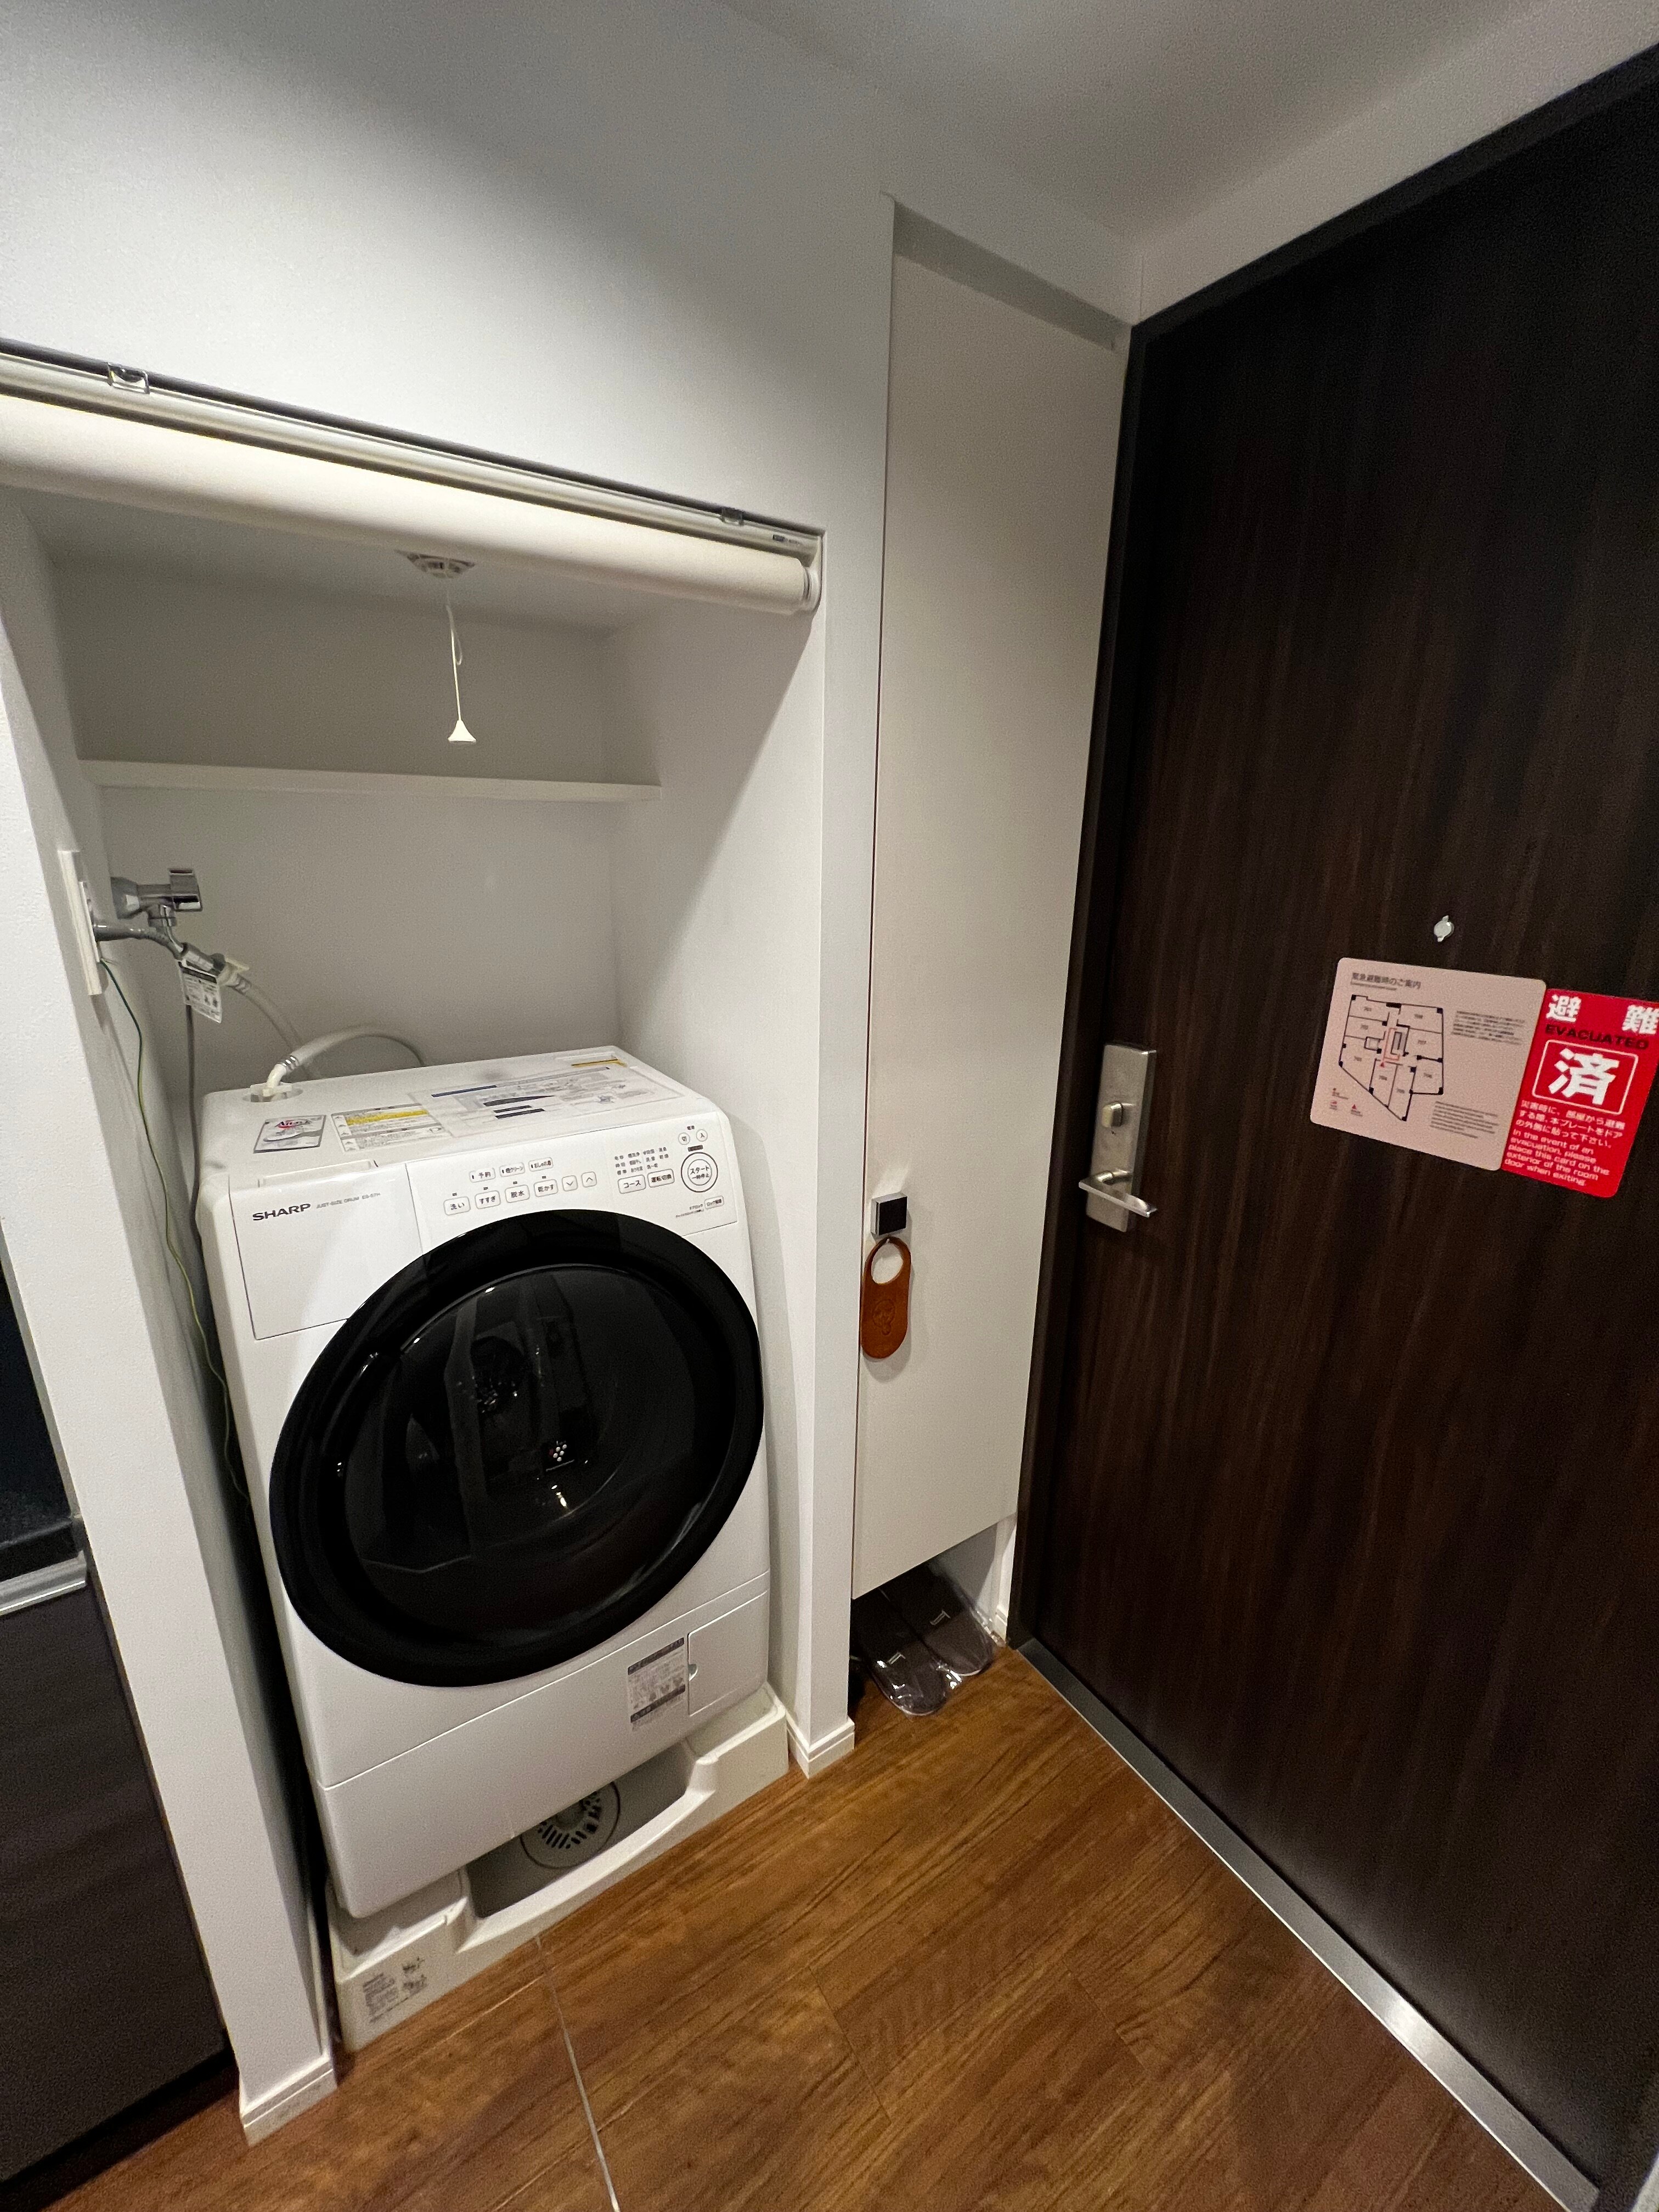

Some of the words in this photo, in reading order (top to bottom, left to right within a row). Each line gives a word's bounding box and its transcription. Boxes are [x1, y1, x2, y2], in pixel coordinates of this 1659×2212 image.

[1546, 994, 1582, 1023] 避
[1622, 1005, 1659, 1035] 難
[1545, 1024, 1649, 1050] EVACUATED
[1548, 1047, 1620, 1106] 済
[1523, 1132, 1539, 1141] the
[1541, 1137, 1567, 1148] event
[1506, 1152, 1542, 1165] exterior
[1556, 1164, 1571, 1173] the
[1573, 1170, 1599, 1181] room
[1508, 1144, 1533, 1155] place
[1535, 1150, 1552, 1160] this
[1554, 1156, 1576, 1166] card
[1578, 1162, 1590, 1171] on
[1593, 1165, 1610, 1176] the
[1564, 1151, 1596, 1164] please
[690, 1165, 710, 1175] スタート
[1504, 1159, 1525, 1168] door
[1527, 1165, 1550, 1176] when
[623, 1180, 641, 1188] コース
[252, 1203, 311, 1221] SHARP
